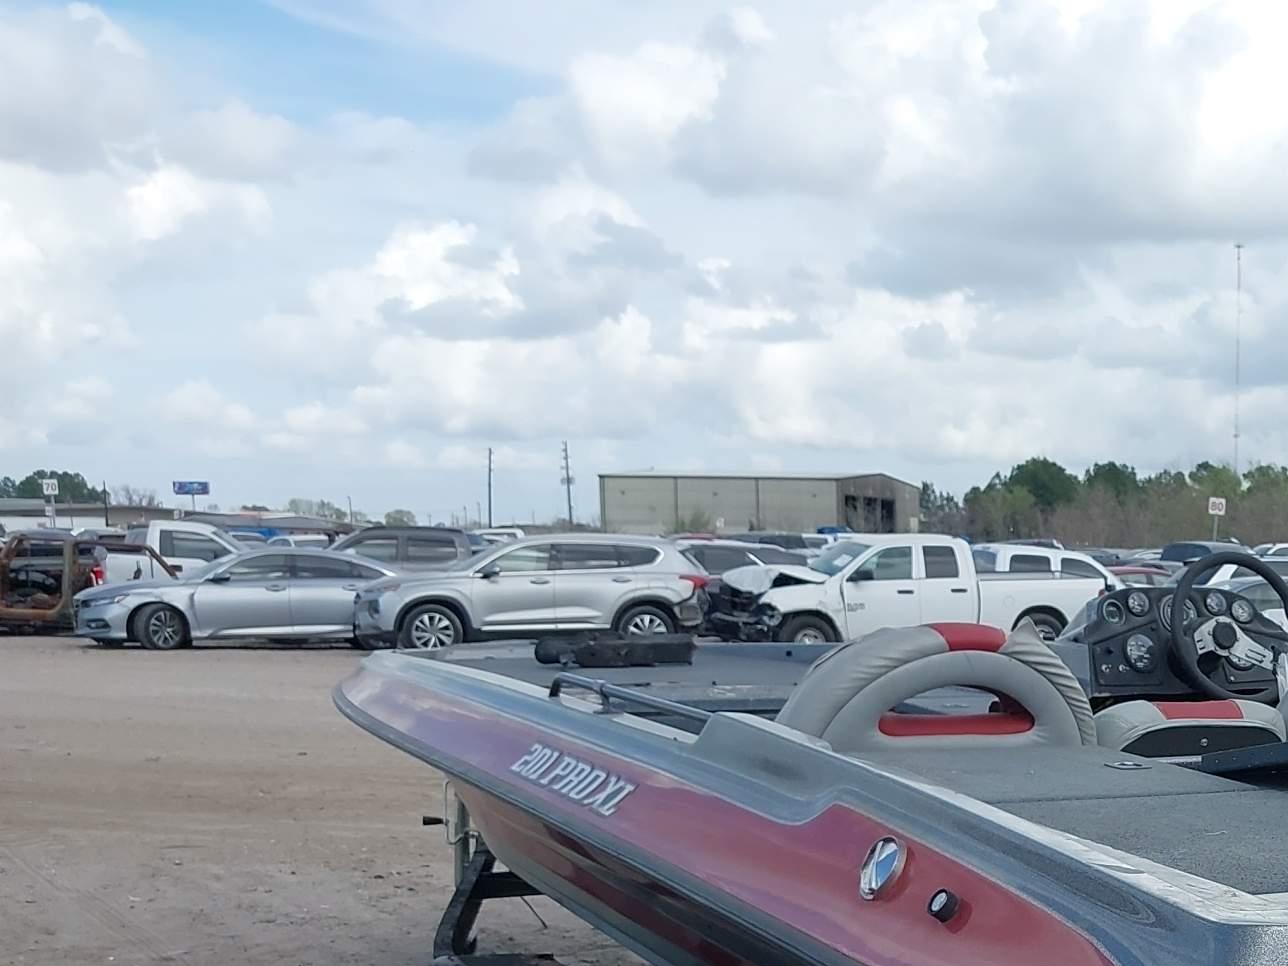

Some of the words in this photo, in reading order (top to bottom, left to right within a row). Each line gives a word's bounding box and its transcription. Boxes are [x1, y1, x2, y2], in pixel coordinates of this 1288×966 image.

[44, 482, 57, 493] 70
[1210, 501, 1225, 512] 80
[509, 742, 562, 780] 201
[540, 756, 609, 800] PRO
[582, 775, 636, 817] XL
